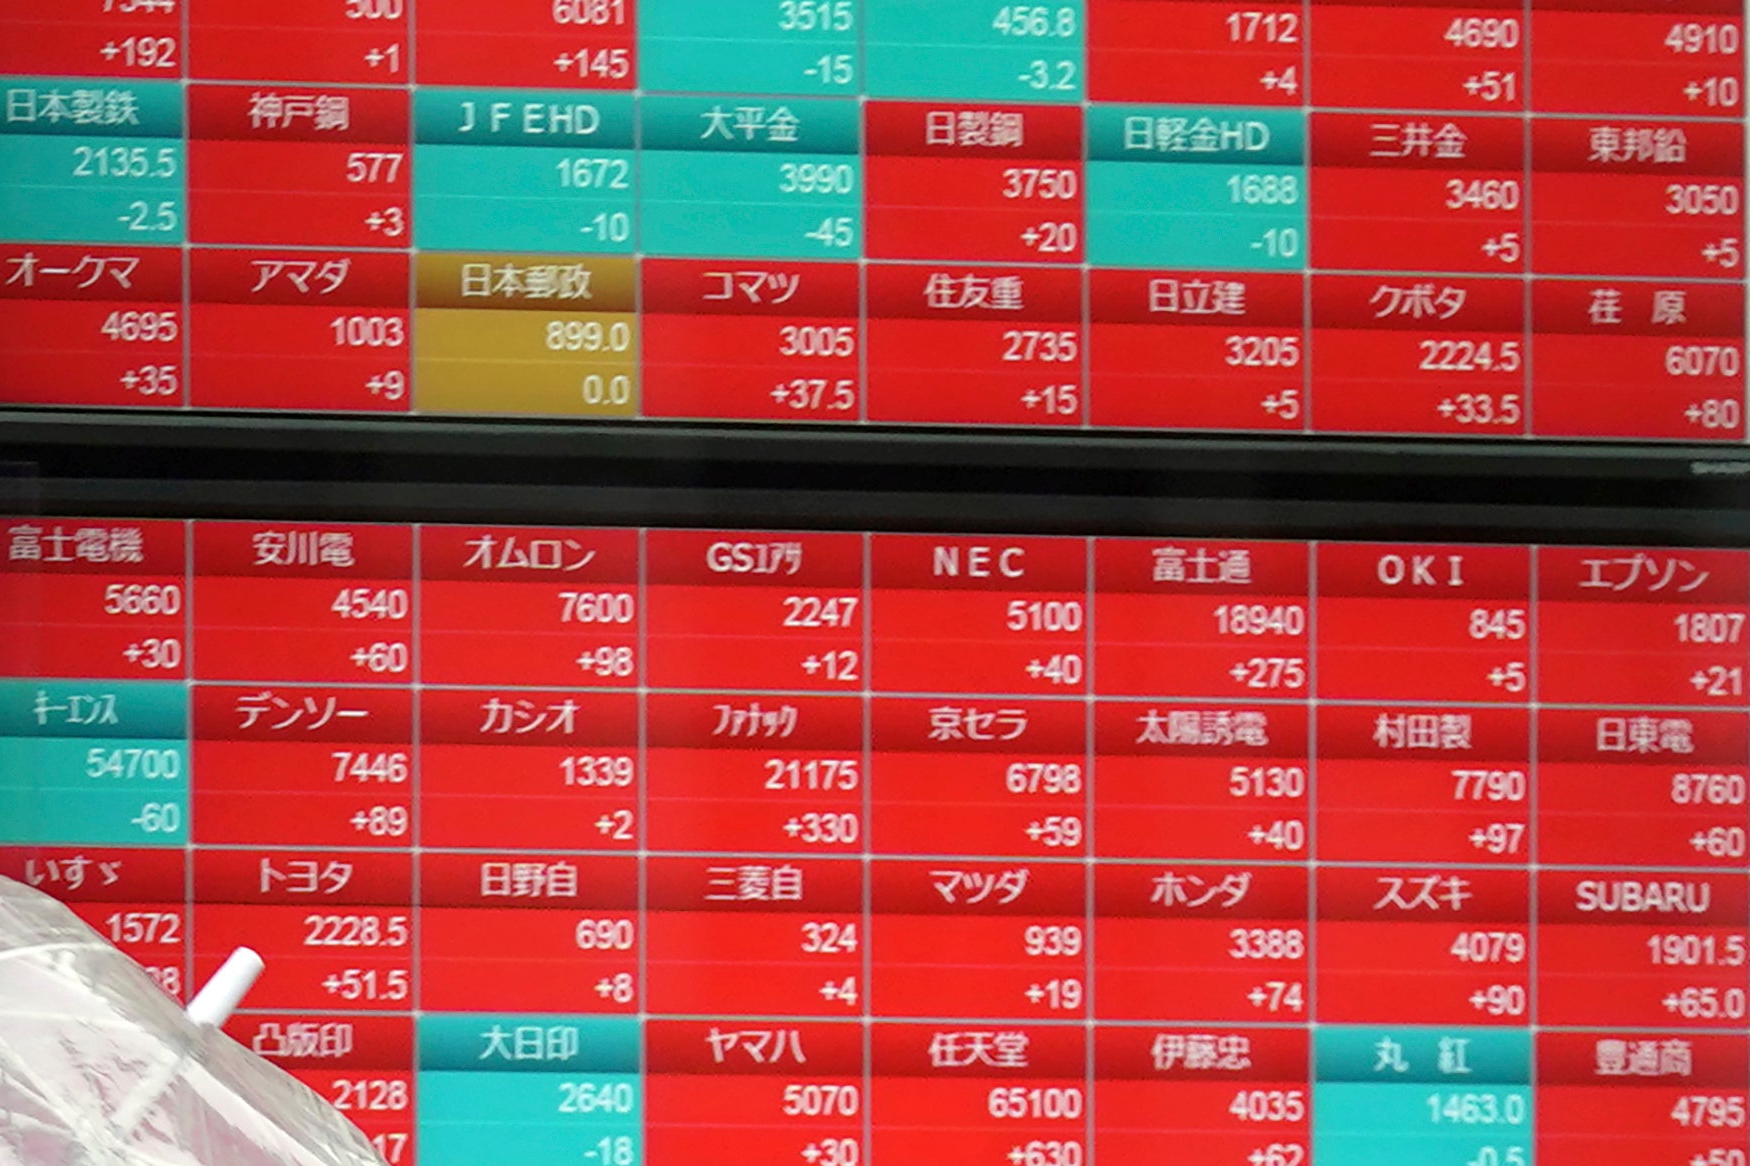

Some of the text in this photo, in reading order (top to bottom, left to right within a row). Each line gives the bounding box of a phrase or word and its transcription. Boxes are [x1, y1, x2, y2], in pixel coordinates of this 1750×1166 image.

[991, 4, 1077, 39] 456.8
[1442, 16, 1520, 50] 4690
[4, 87, 142, 129] 日本製鉄
[699, 104, 801, 143] 大平金
[925, 110, 1024, 149] 日製鋼
[1124, 115, 1270, 154] 日軽金HD
[1369, 121, 1468, 159] 三井金
[345, 151, 405, 184] 577
[778, 161, 855, 196] 3990
[1225, 173, 1300, 206] 1688
[1664, 182, 1741, 217] 3050
[1019, 220, 1078, 254] +20
[5, 251, 141, 290] オークマ
[250, 257, 352, 295] アマダ
[460, 261, 593, 301] 日本郵政
[702, 270, 801, 305] コマツ
[922, 272, 1025, 311] 住友重
[1148, 277, 1247, 316] 日立建
[1368, 282, 1467, 321] クボタ
[100, 310, 179, 343] 4695
[544, 319, 631, 354] 899.0
[1001, 329, 1078, 363] 2735
[1418, 338, 1522, 373] 2224.5
[7, 523, 144, 564] 富士電機
[252, 529, 356, 569] 安川電
[463, 533, 597, 572] オムロン
[1151, 545, 1252, 585] 富士通
[1578, 551, 1711, 593] エプソン
[330, 587, 409, 621] 4540
[782, 595, 860, 628] 2247
[1213, 603, 1305, 637] 18940
[1673, 611, 1747, 645] 1807
[121, 637, 182, 670] +30
[236, 690, 370, 731] デンソー
[479, 696, 581, 735] カシオ
[927, 705, 1029, 742] 京セラ
[1372, 712, 1473, 750] 村田製
[1595, 715, 1695, 755] 日東電
[85, 746, 182, 781] 54700
[558, 754, 635, 788] 1339
[1005, 761, 1083, 795] 6798
[1450, 768, 1527, 802] 7790
[1688, 825, 1747, 858] +60
[23, 856, 123, 891] いすゞ
[259, 857, 354, 895] トヨタ
[480, 859, 578, 898] 日野自
[704, 863, 804, 902] 三菱自
[928, 867, 1031, 905] マツダ
[1149, 870, 1254, 909] ホンダ
[1372, 873, 1473, 912] スズキ
[1575, 879, 1711, 915] SUBARU
[800, 920, 859, 954] 324
[1228, 927, 1306, 961] 3388
[1646, 933, 1747, 968] 1901.5
[478, 1023, 580, 1062] 大日印
[704, 1026, 807, 1064] ヤマハ
[927, 1030, 1030, 1069] 任天堂
[556, 1081, 635, 1115] 2640
[987, 1086, 1083, 1120] 65100
[1426, 1092, 1526, 1126] 1463.0
